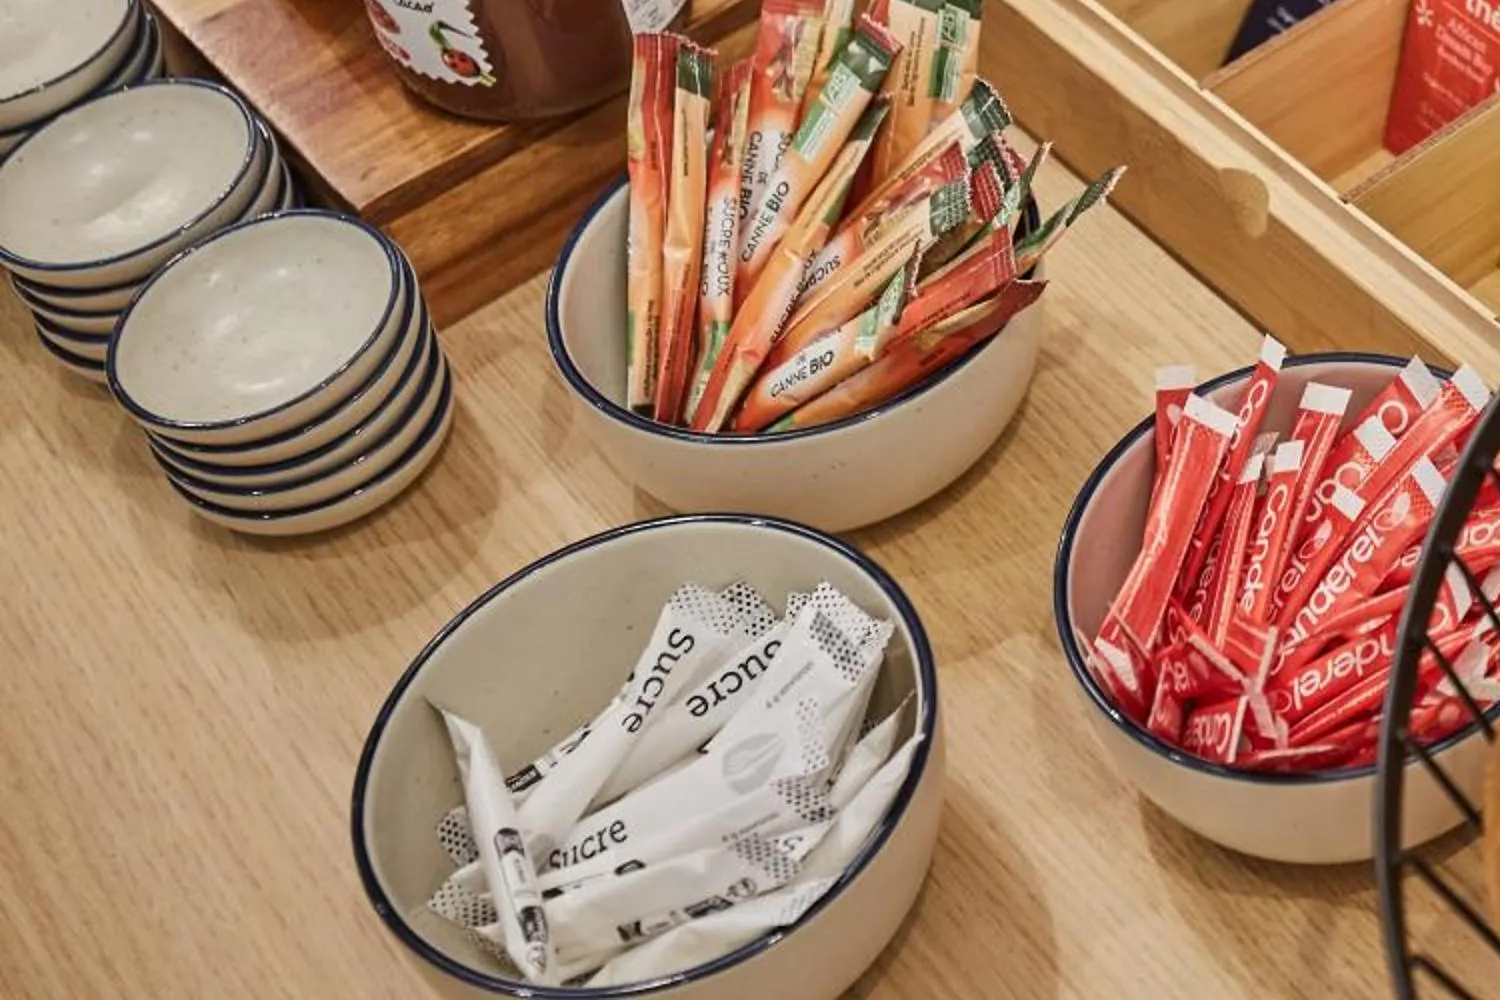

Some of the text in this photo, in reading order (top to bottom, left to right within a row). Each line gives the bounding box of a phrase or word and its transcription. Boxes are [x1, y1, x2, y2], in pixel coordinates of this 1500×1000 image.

[717, 195, 738, 251] SUCRE
[741, 180, 790, 263] CANNE BIO
[770, 350, 835, 399] CANNE BIO
[1240, 483, 1289, 613] Cande
[1269, 525, 1385, 676] Canderel
[621, 627, 696, 734] Sucre
[1290, 632, 1394, 711] nderel
